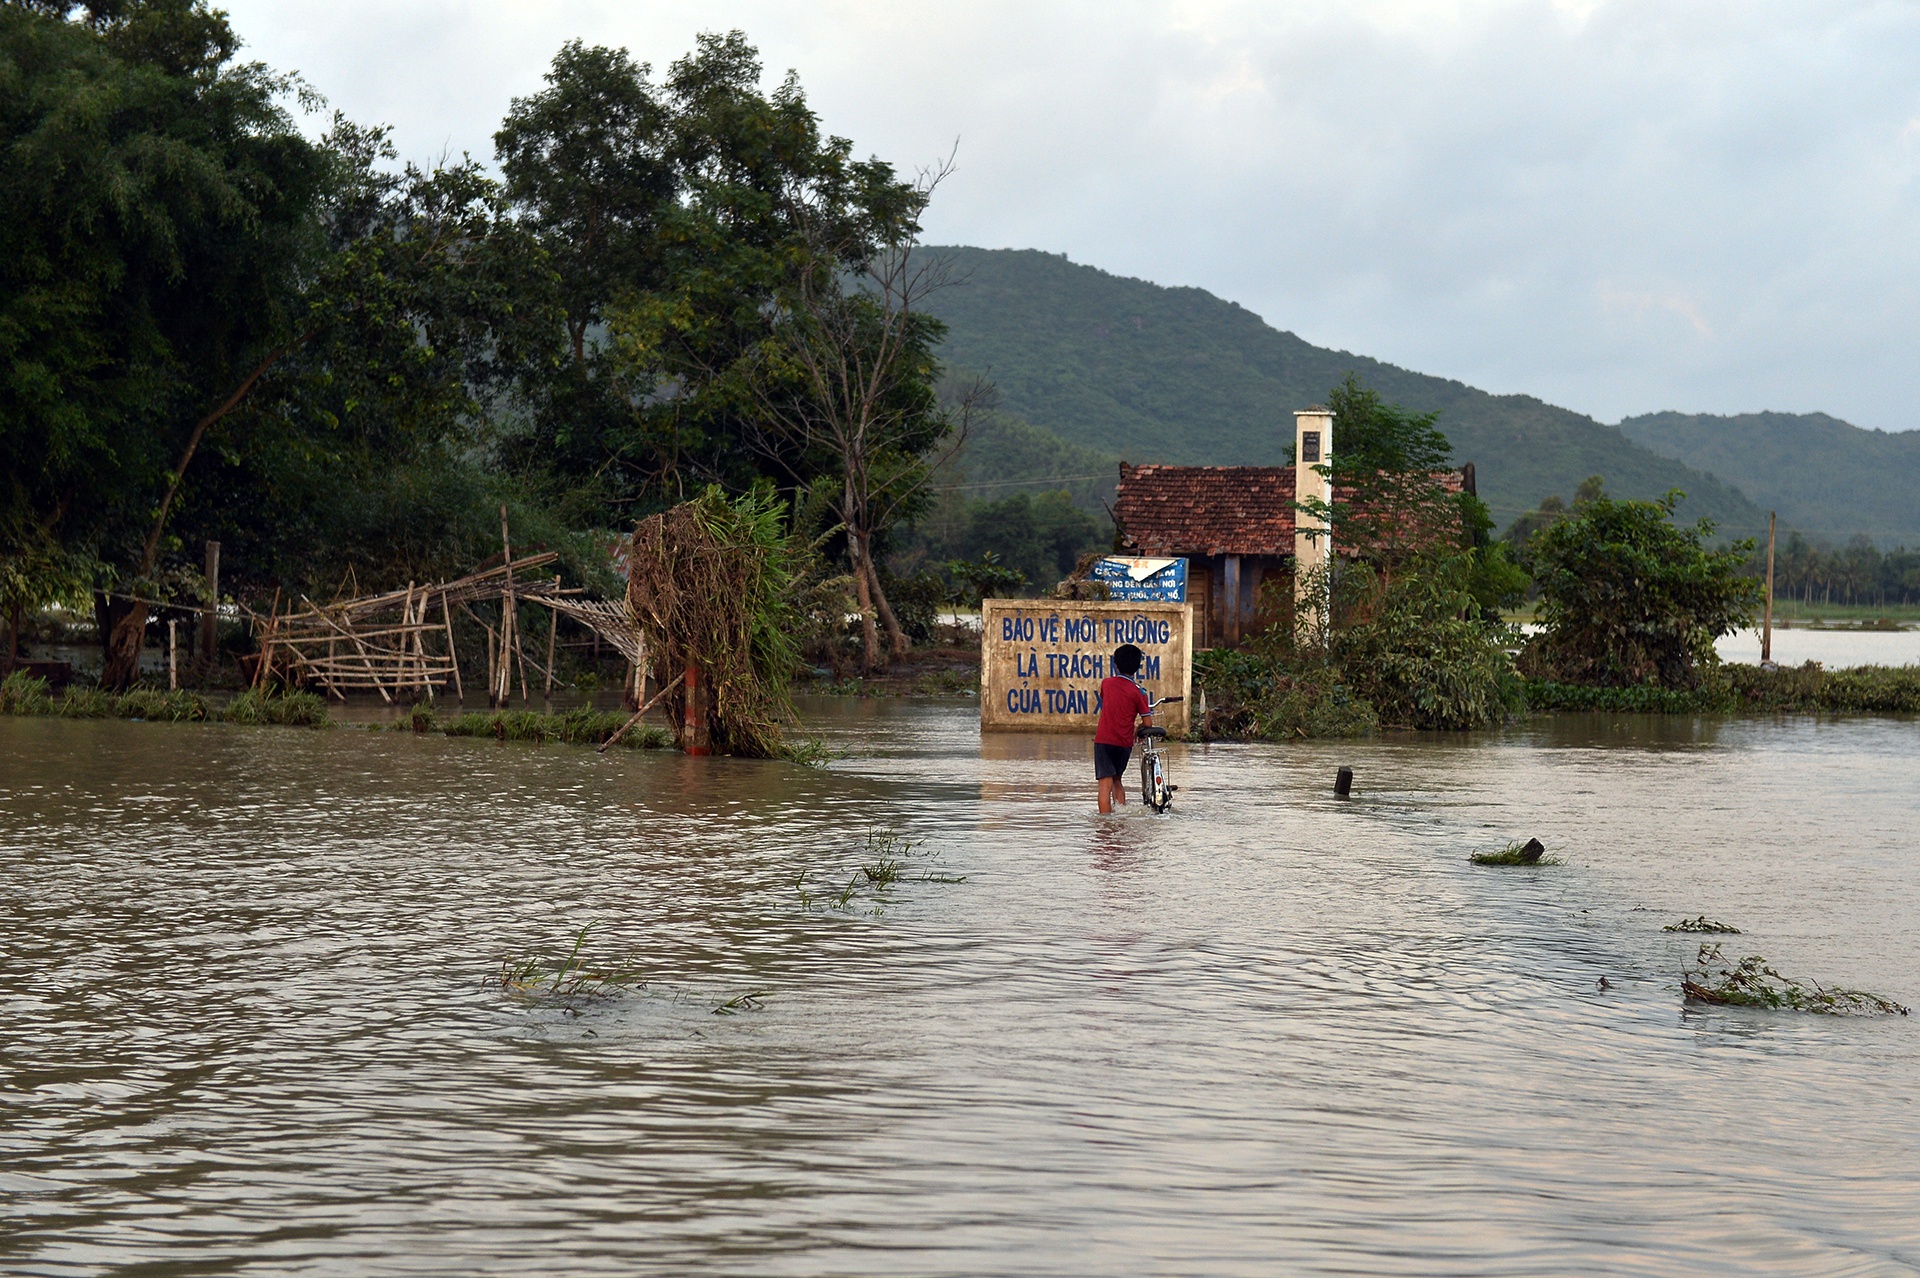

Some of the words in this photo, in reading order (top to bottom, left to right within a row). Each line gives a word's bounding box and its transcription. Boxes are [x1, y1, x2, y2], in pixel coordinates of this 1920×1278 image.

[1002, 609, 1034, 642] BẢO
[1038, 613, 1059, 646] VỆ
[1065, 614, 1097, 643] MÔI
[1102, 613, 1170, 645] TRƯỜNG
[1017, 647, 1039, 678] LÀ
[1046, 648, 1103, 679] TRÁCH
[1007, 681, 1043, 714] CỦA
[1045, 684, 1089, 715] TOÀN
